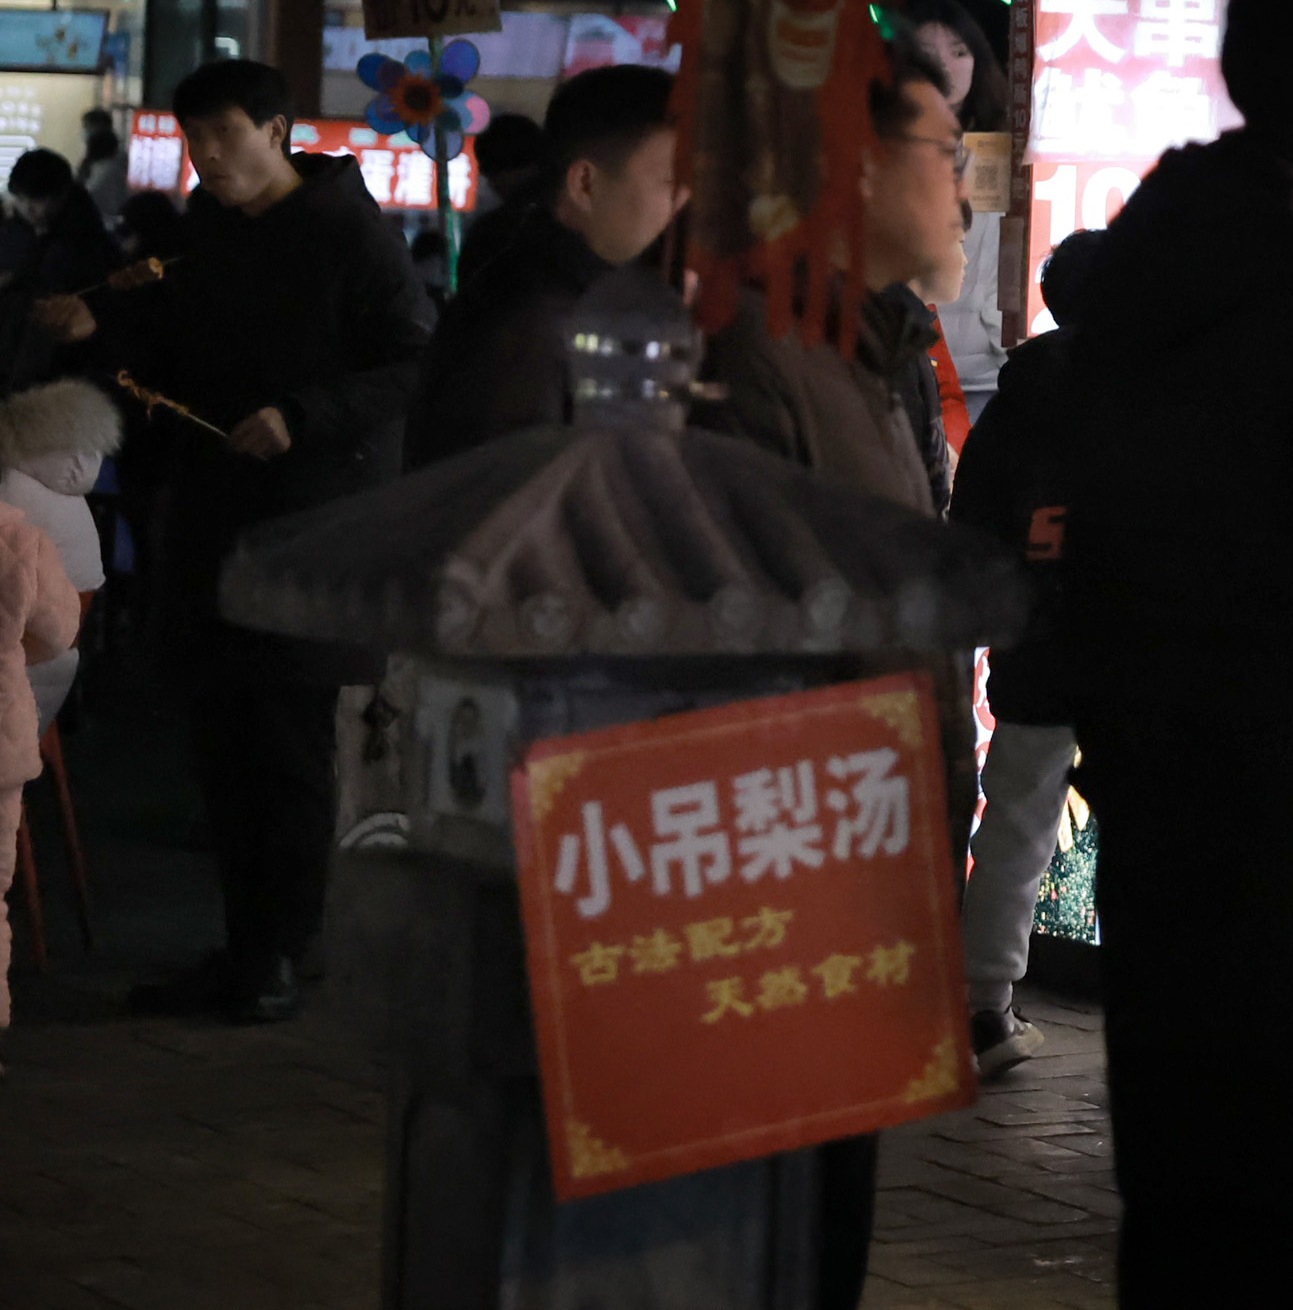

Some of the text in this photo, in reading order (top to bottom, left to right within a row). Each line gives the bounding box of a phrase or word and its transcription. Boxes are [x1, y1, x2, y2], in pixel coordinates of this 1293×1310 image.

[554, 746, 911, 919] 小吊梨汤
[571, 906, 794, 987] 古法配方
[700, 940, 916, 1024] 天然食材
